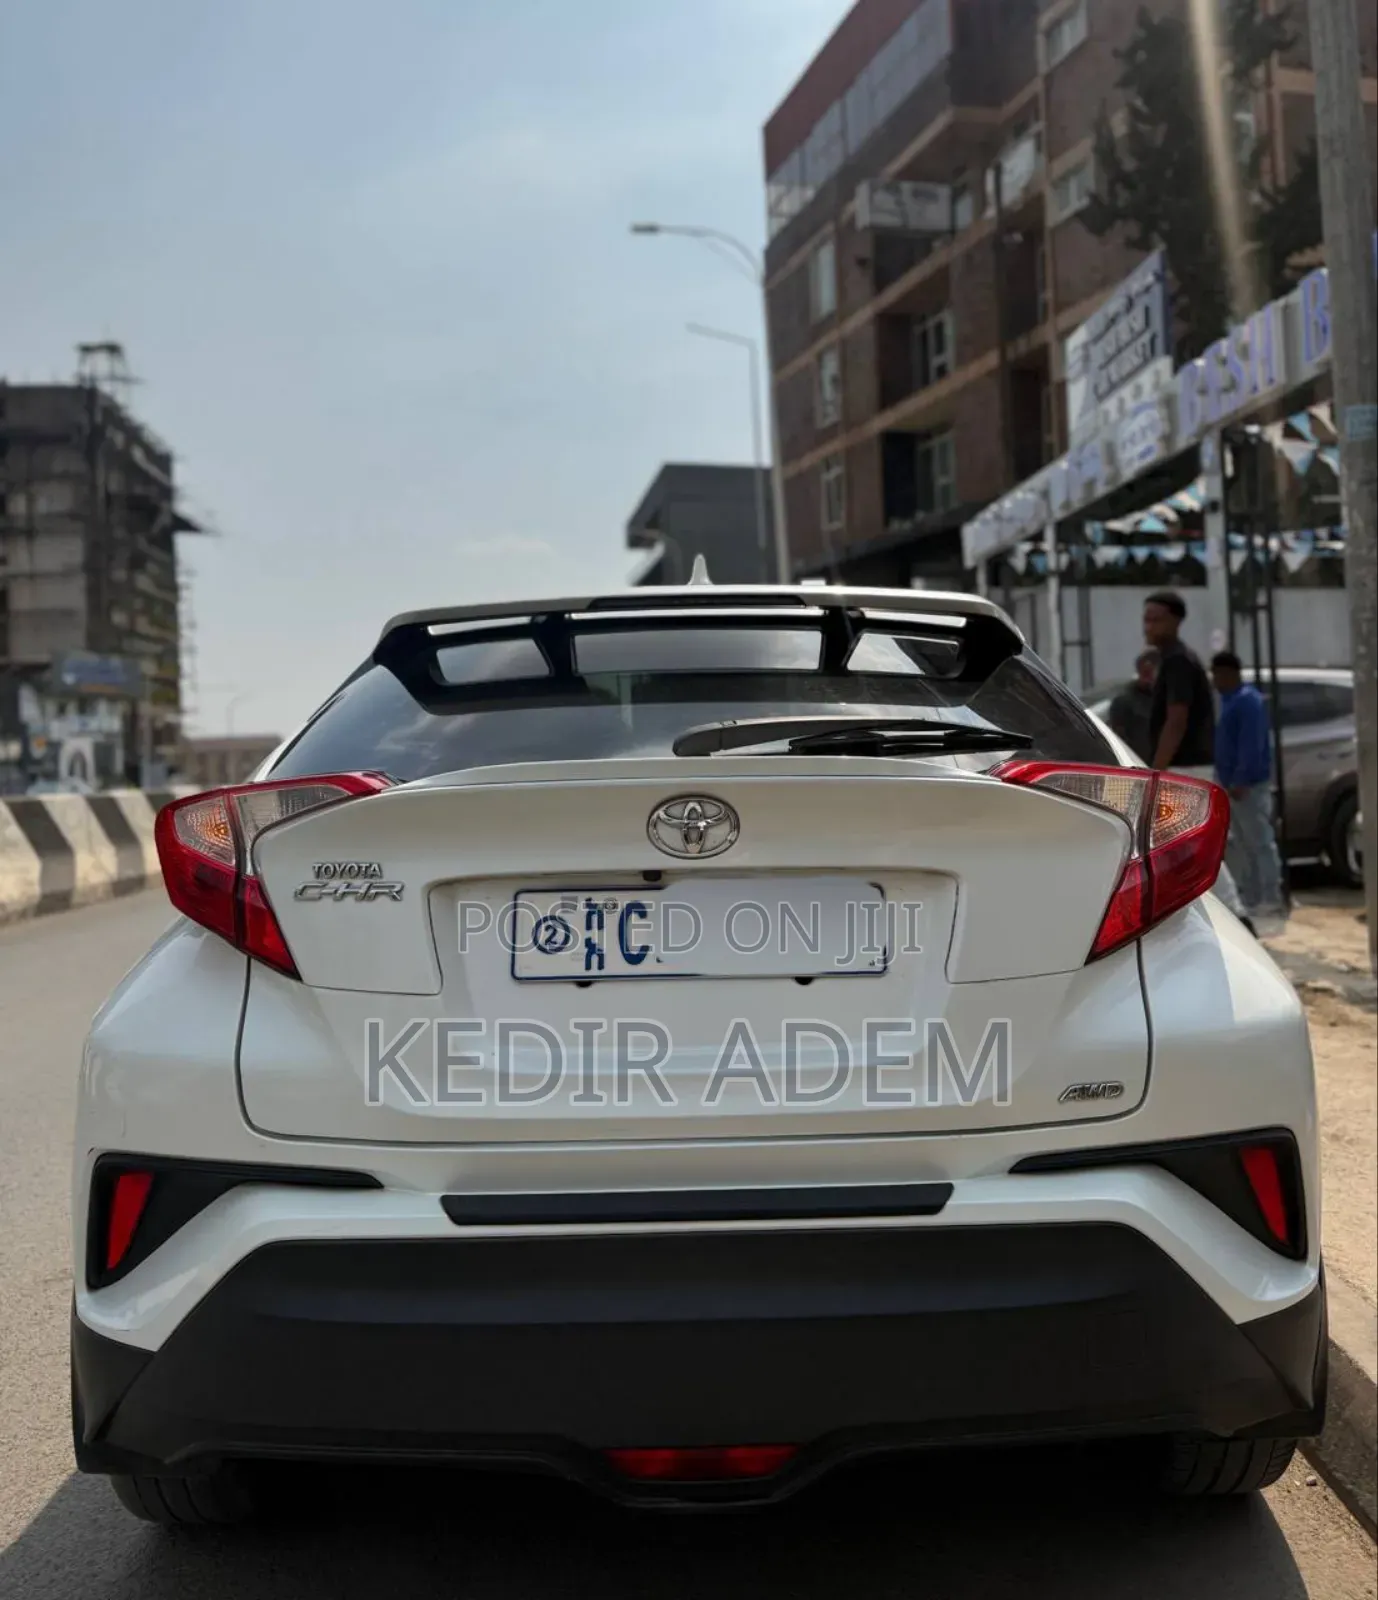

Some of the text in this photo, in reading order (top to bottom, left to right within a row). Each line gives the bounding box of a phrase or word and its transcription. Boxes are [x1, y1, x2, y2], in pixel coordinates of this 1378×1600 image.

[312, 862, 382, 879] TOYOTA
[294, 882, 404, 901] C-HR
[618, 901, 650, 965] C
[1058, 1081, 1123, 1102] AWD
